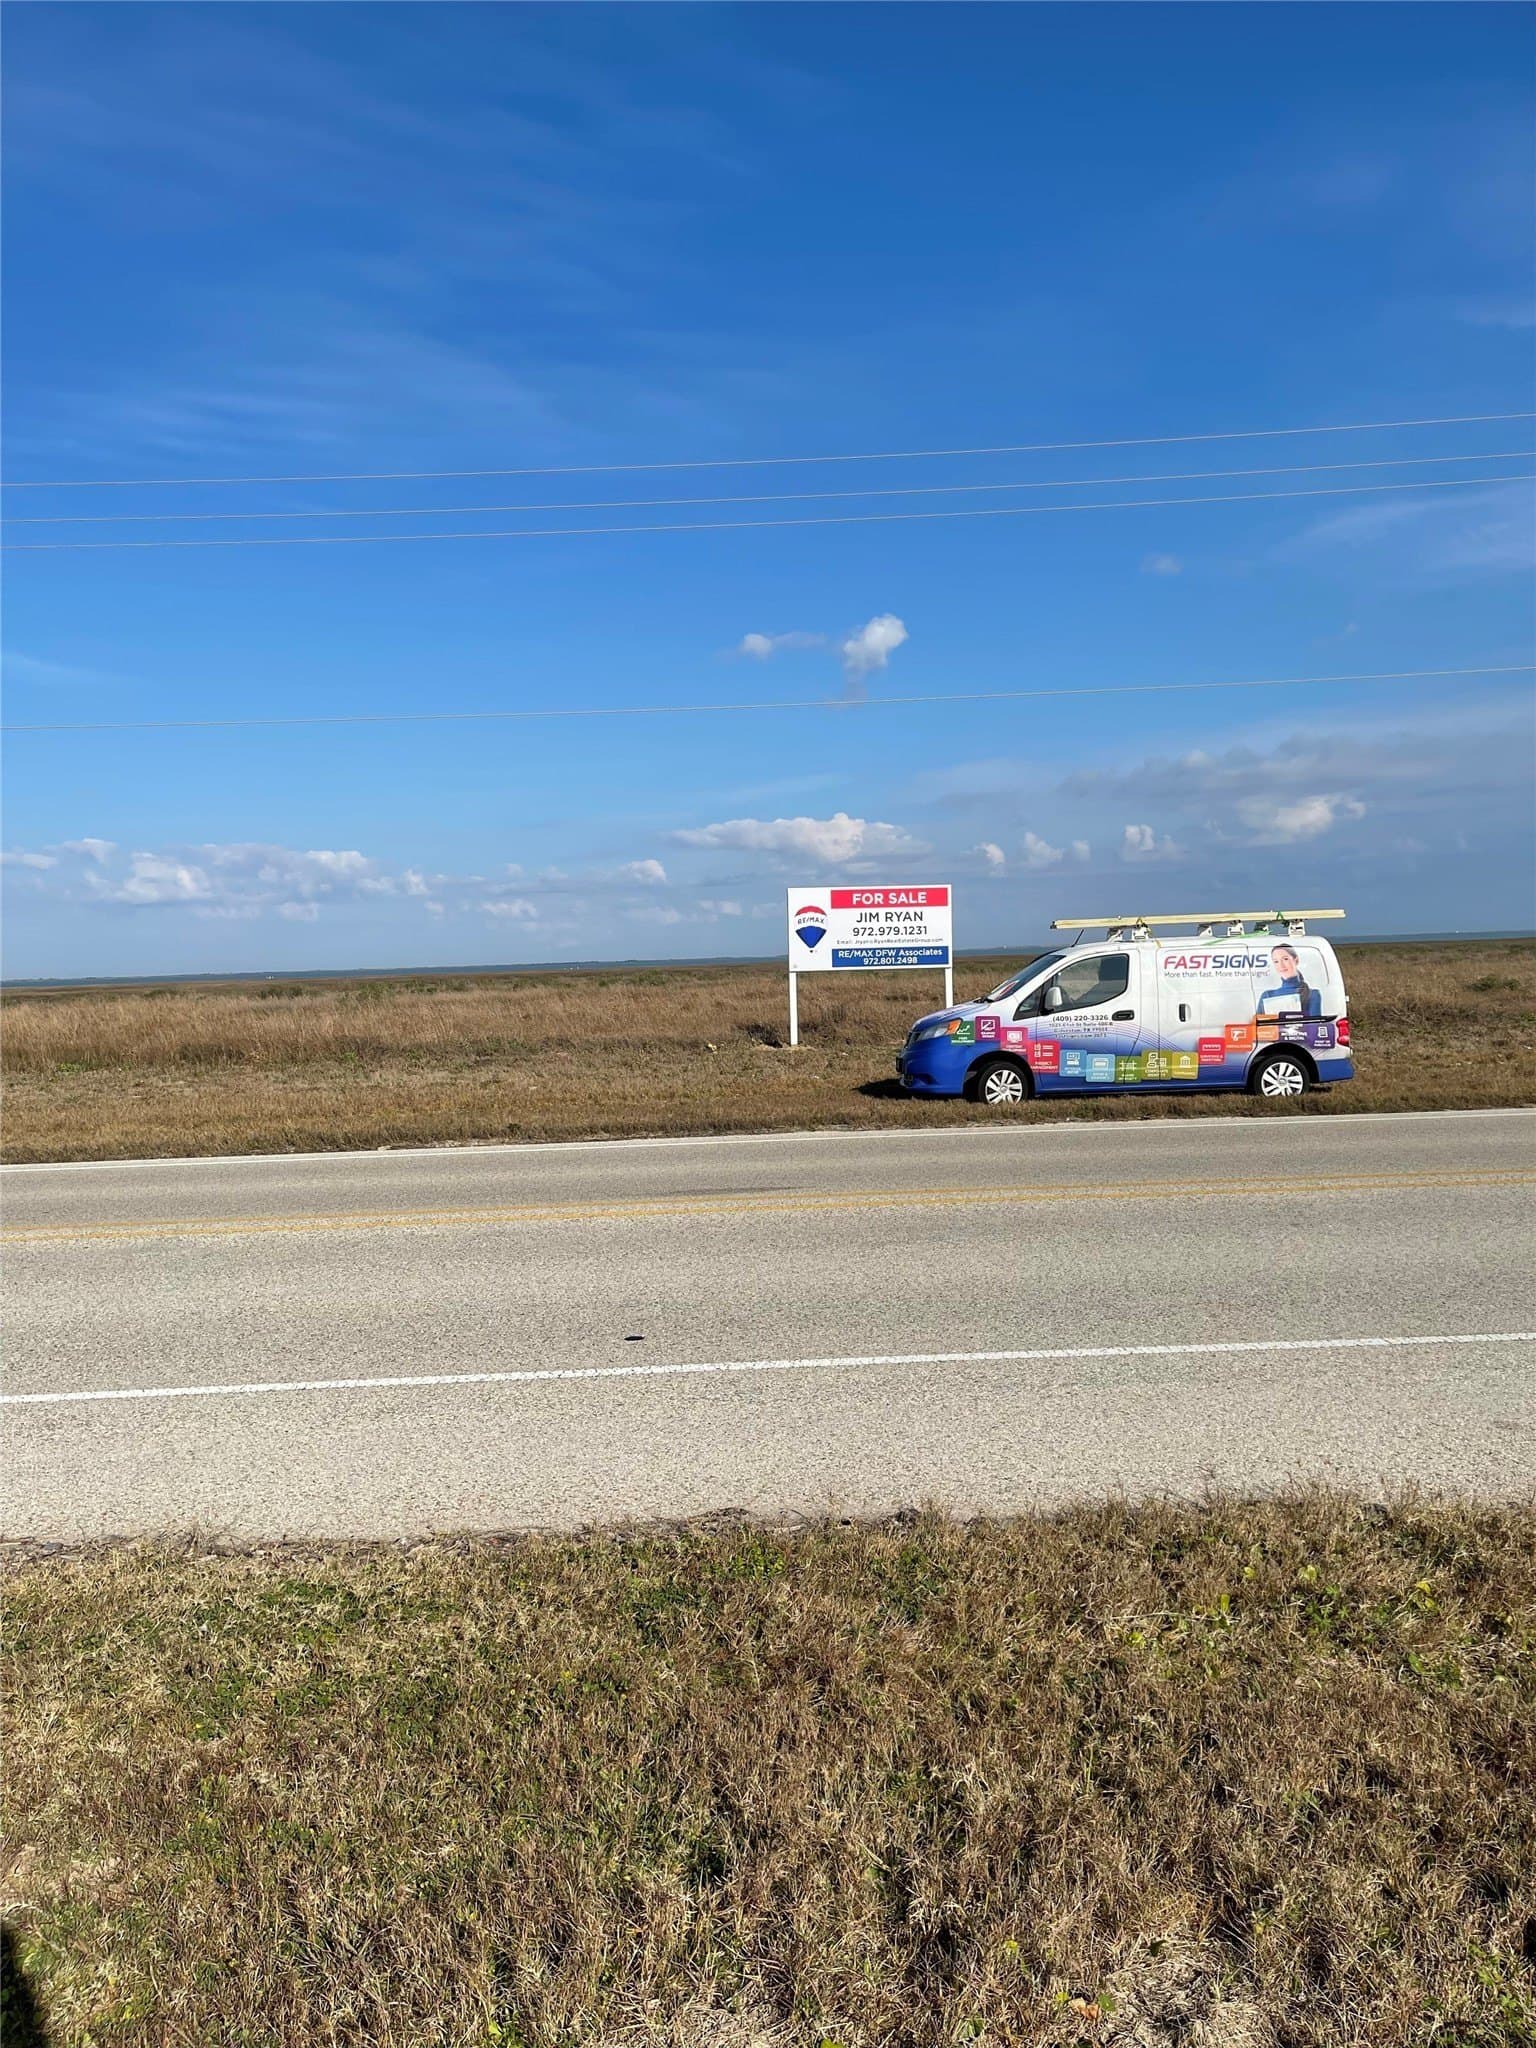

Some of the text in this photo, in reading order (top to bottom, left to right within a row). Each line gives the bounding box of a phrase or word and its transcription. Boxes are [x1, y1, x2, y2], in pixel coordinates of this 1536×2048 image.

[852, 892, 927, 905] FOR SALE
[797, 916, 825, 924] RE/MAX
[856, 911, 924, 923] JIM RYAN
[852, 925, 928, 937] 972.979.1231
[838, 948, 943, 958] RE/MAX DFW Associates
[863, 957, 918, 965] 972.801.2498
[1164, 954, 1268, 970] FASTSIGNS
[1052, 1015, 1072, 1023] (409)
